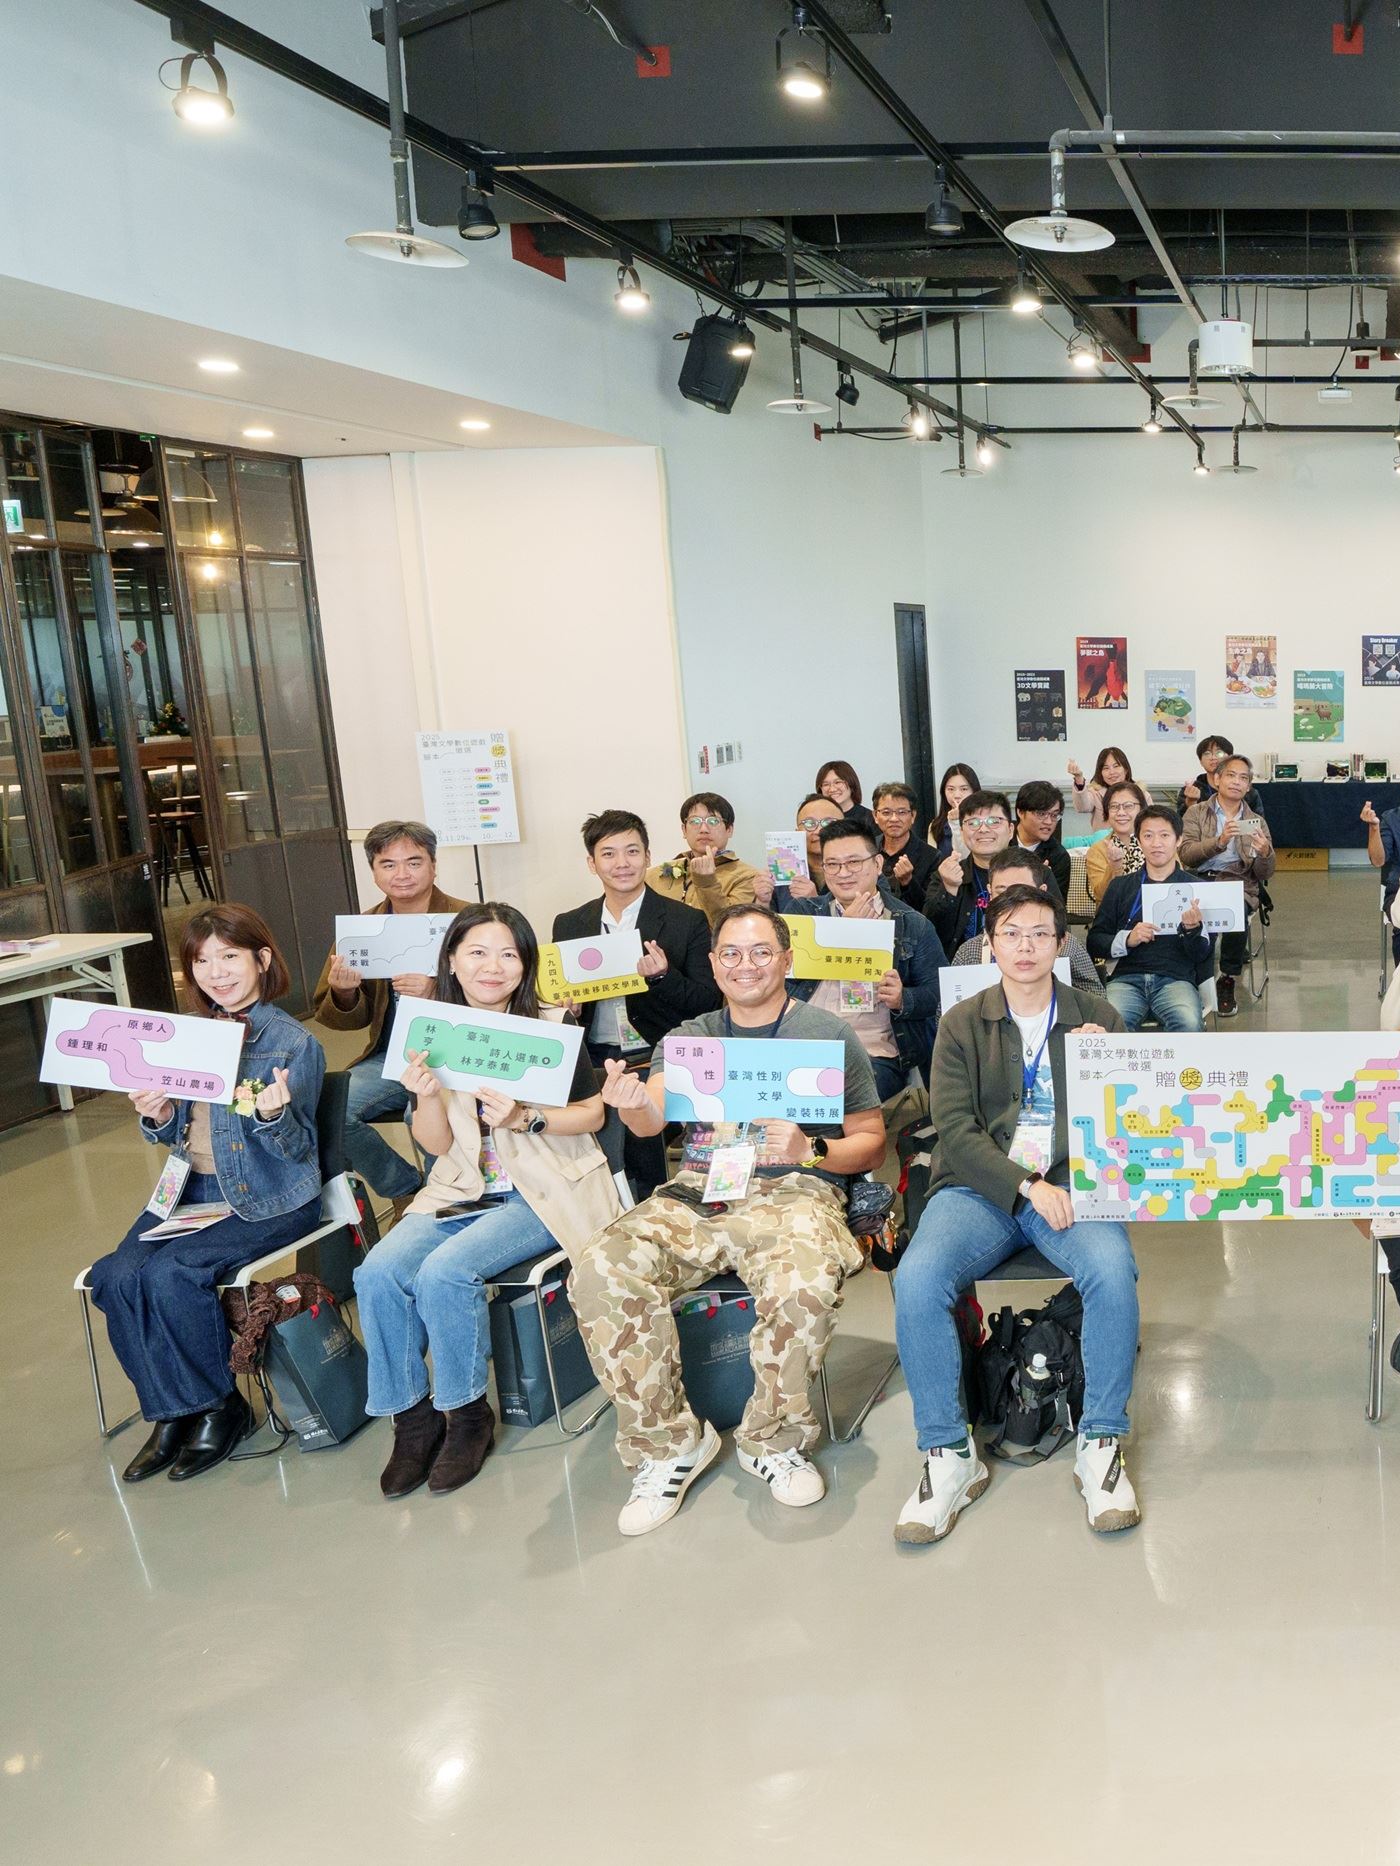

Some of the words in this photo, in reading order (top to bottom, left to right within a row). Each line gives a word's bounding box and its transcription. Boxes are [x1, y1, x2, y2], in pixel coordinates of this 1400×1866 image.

[349, 949, 369, 957] 不服
[349, 959, 369, 967] 來戰
[825, 955, 873, 965] 臺灣男子簡
[546, 952, 560, 986] 一九四九
[552, 979, 640, 1001] 臺灣戰後移民文學展
[127, 1019, 167, 1034] 原鄉人
[466, 1031, 490, 1044] 臺灣
[1078, 1038, 1106, 1048] 2025
[67, 1038, 108, 1052] 鍾理和
[1079, 1049, 1175, 1060] 臺灣文學數位遊戲
[461, 1056, 511, 1072] 林亨泰集
[1127, 1061, 1152, 1072] 徵選
[704, 1070, 715, 1080] 性
[728, 1070, 782, 1081] 臺灣性別
[1079, 1070, 1104, 1080] 腳本
[1155, 1071, 1249, 1089] 贈獎典禮
[161, 1075, 215, 1091] 笠山農場
[757, 1091, 783, 1101] 文學
[786, 1107, 840, 1118] 變裝特展
